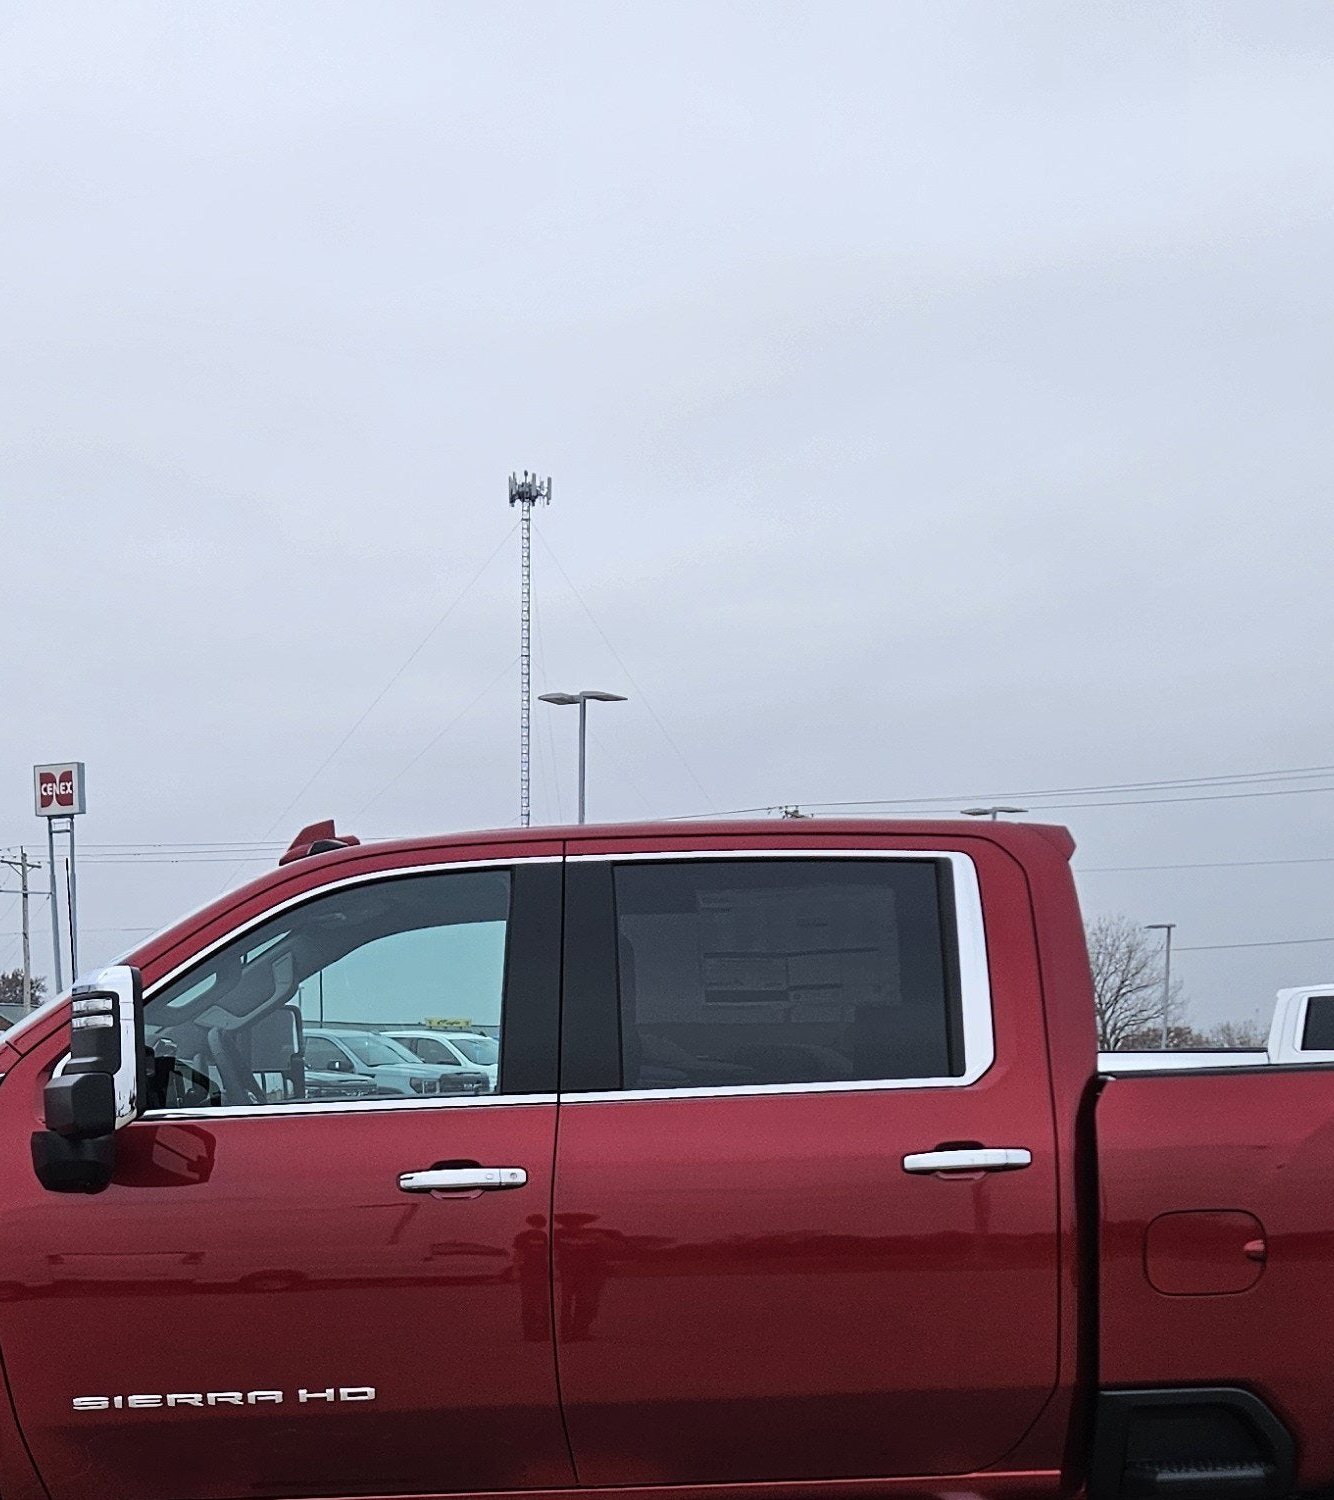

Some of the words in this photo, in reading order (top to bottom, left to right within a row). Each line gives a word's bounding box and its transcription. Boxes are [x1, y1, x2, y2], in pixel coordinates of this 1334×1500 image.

[41, 781, 73, 796] CENEX
[72, 1390, 284, 1411] SIERRA
[298, 1387, 376, 1403] HD
